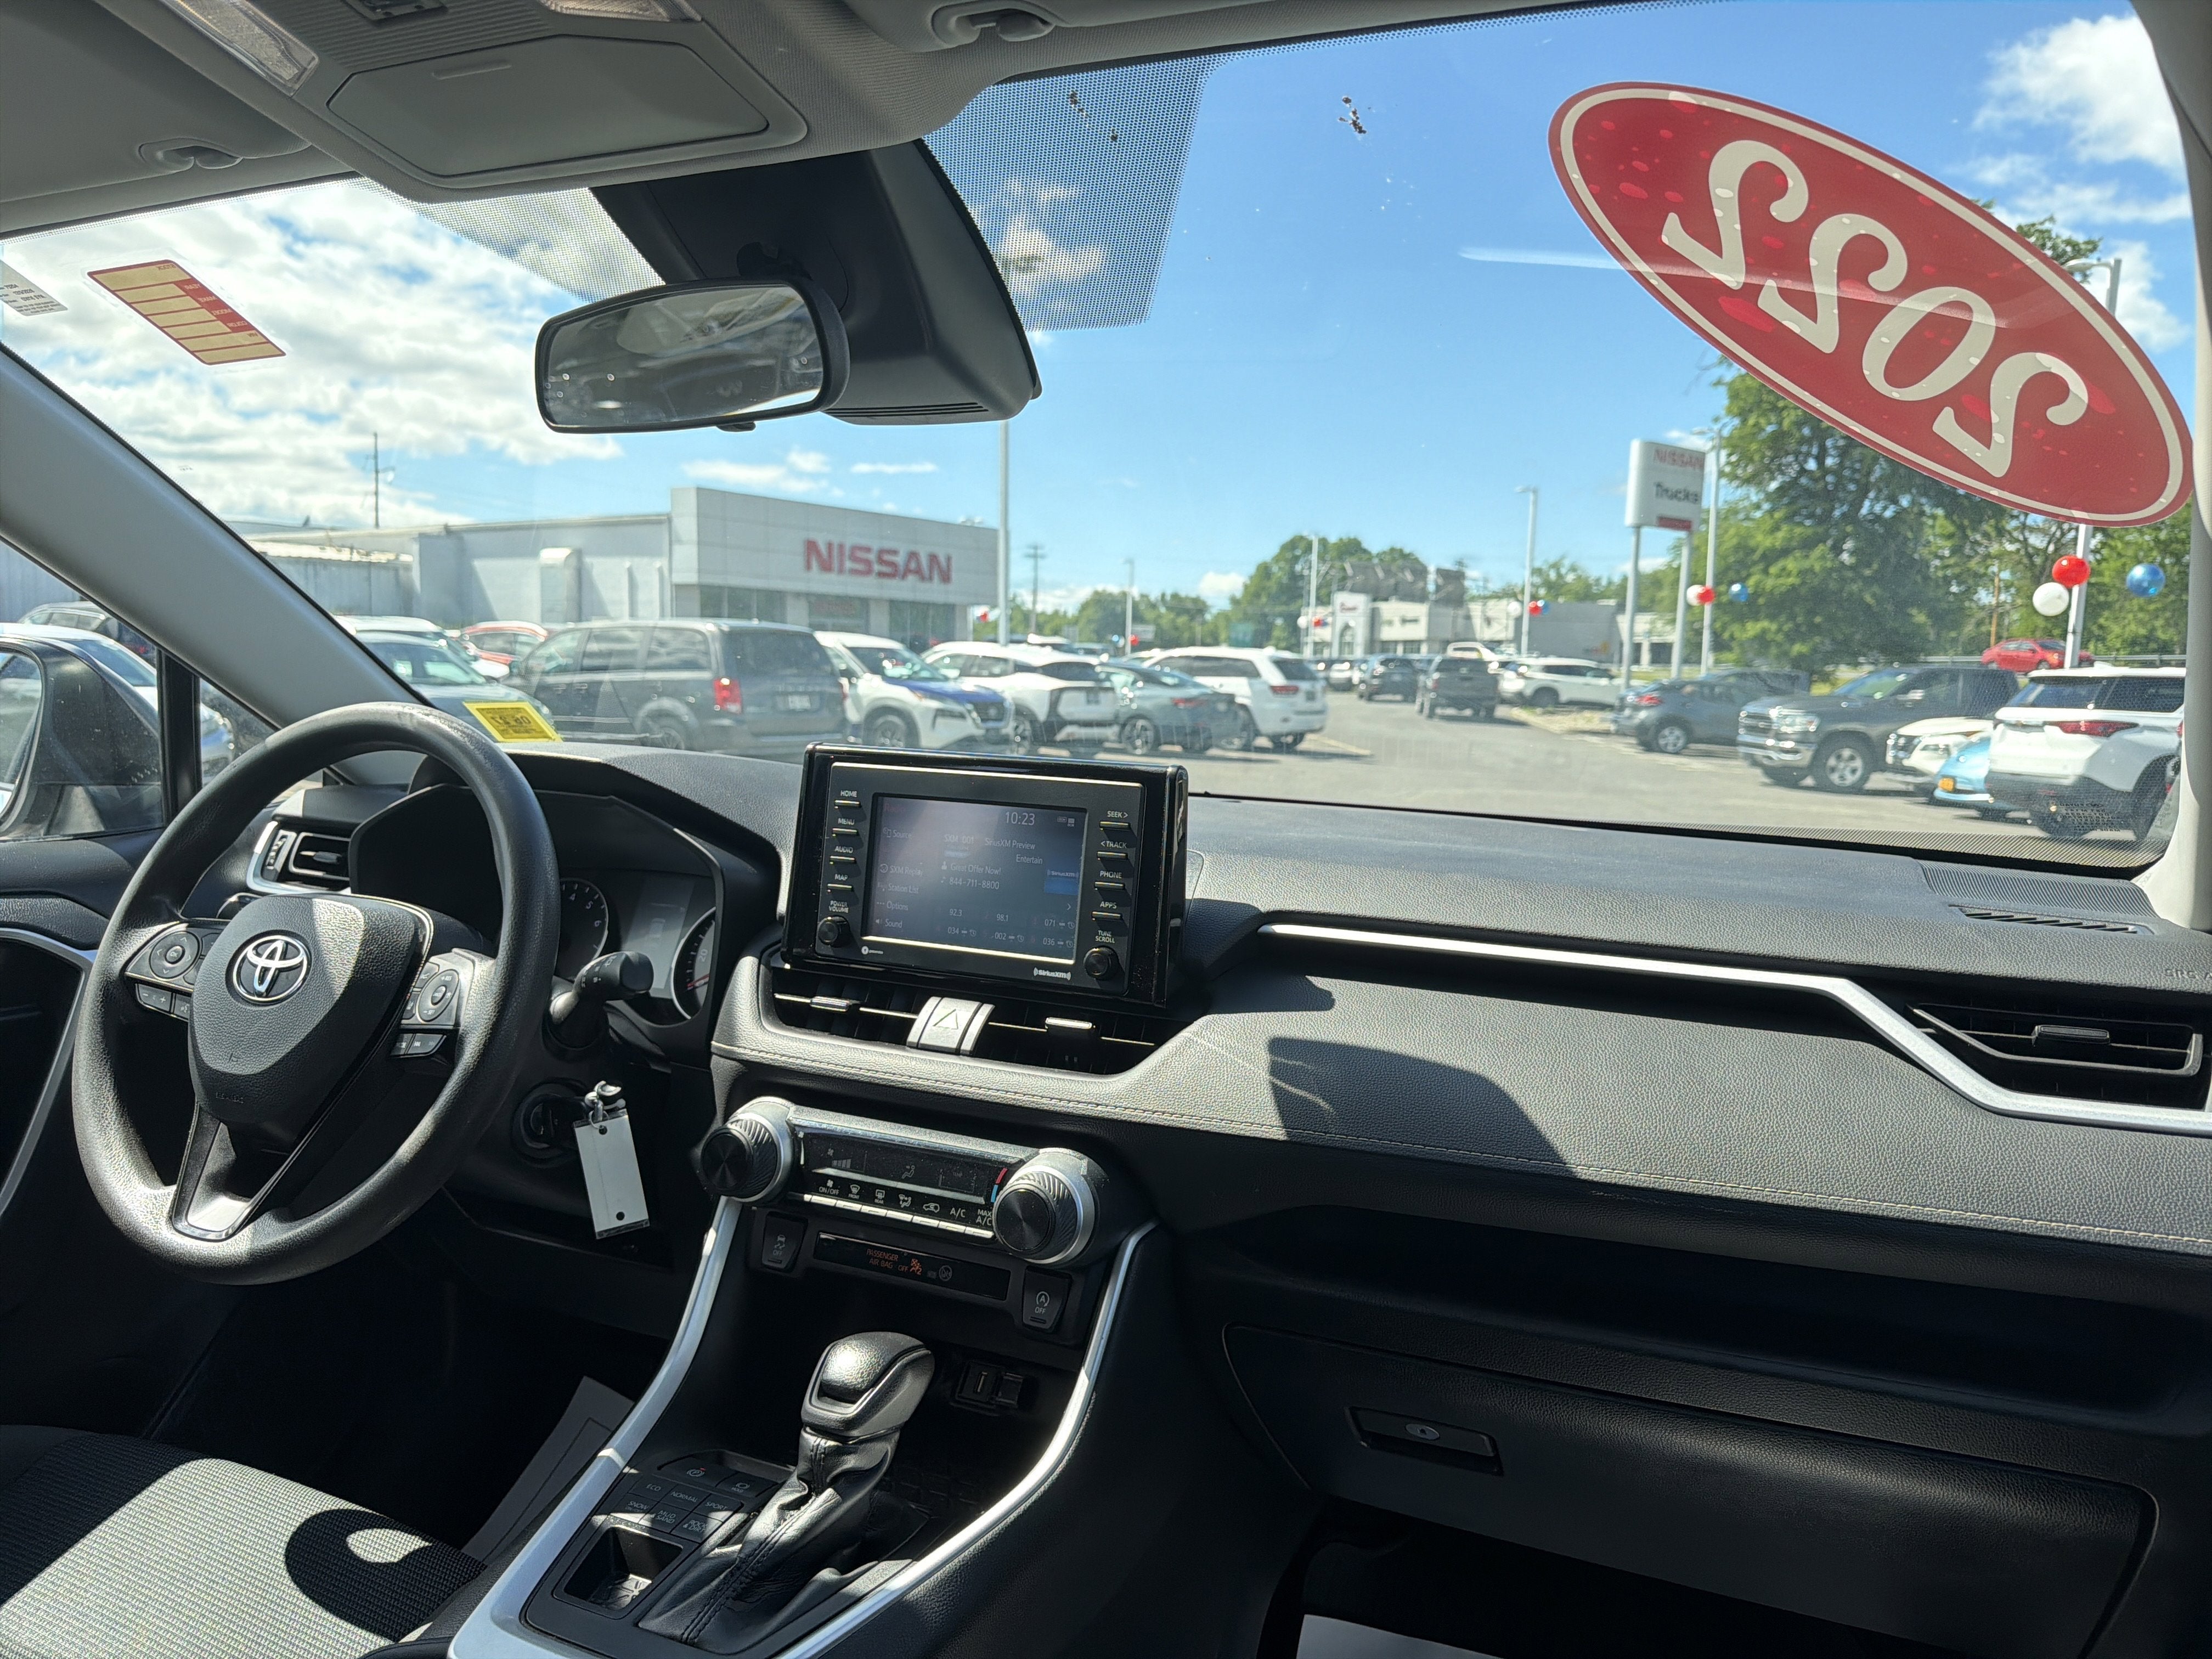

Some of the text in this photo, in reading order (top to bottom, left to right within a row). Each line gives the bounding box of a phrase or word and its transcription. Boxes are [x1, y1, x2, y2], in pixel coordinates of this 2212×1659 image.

[804, 539, 953, 584] NISSAN
[1005, 811, 1035, 826] 10:23
[893, 830, 912, 839] Source
[962, 836, 974, 844] 001
[984, 837, 1011, 848] SiriusXM
[1012, 840, 1036, 850] Preview
[1106, 840, 1127, 849] TRACK
[1016, 854, 1042, 865] Entertain
[905, 866, 923, 877] Replay
[950, 863, 1001, 875] Great Offer Now!
[1099, 870, 1122, 879] PHONE
[888, 883, 919, 894] Station List
[887, 901, 909, 911] Options
[1100, 901, 1117, 909] APPS
[950, 909, 962, 917] 92.3
[996, 913, 1008, 922] 98.1
[885, 919, 902, 928] Sound
[1044, 919, 1056, 927] 071
[947, 926, 959, 935] 034
[1043, 938, 1055, 946] 036
[819, 1186, 840, 1196] ON/OFF
[950, 1207, 966, 1219] A/C
[977, 1209, 992, 1217] MAX
[976, 1215, 992, 1226] A/C
[866, 1248, 899, 1261] PASSENGER
[869, 1258, 893, 1269] AIR BAG
[898, 1265, 909, 1273] OFF
[1035, 1306, 1046, 1314] OFF
[646, 1483, 661, 1492] ECO
[670, 1491, 698, 1503] NORMAL
[628, 1500, 650, 1510] SNOW
[705, 1501, 728, 1510] SPORT
[658, 1510, 676, 1519] MUD
[655, 1515, 676, 1524] SAND
[688, 1520, 708, 1528] ROCK
[689, 1525, 706, 1533] DIRT
